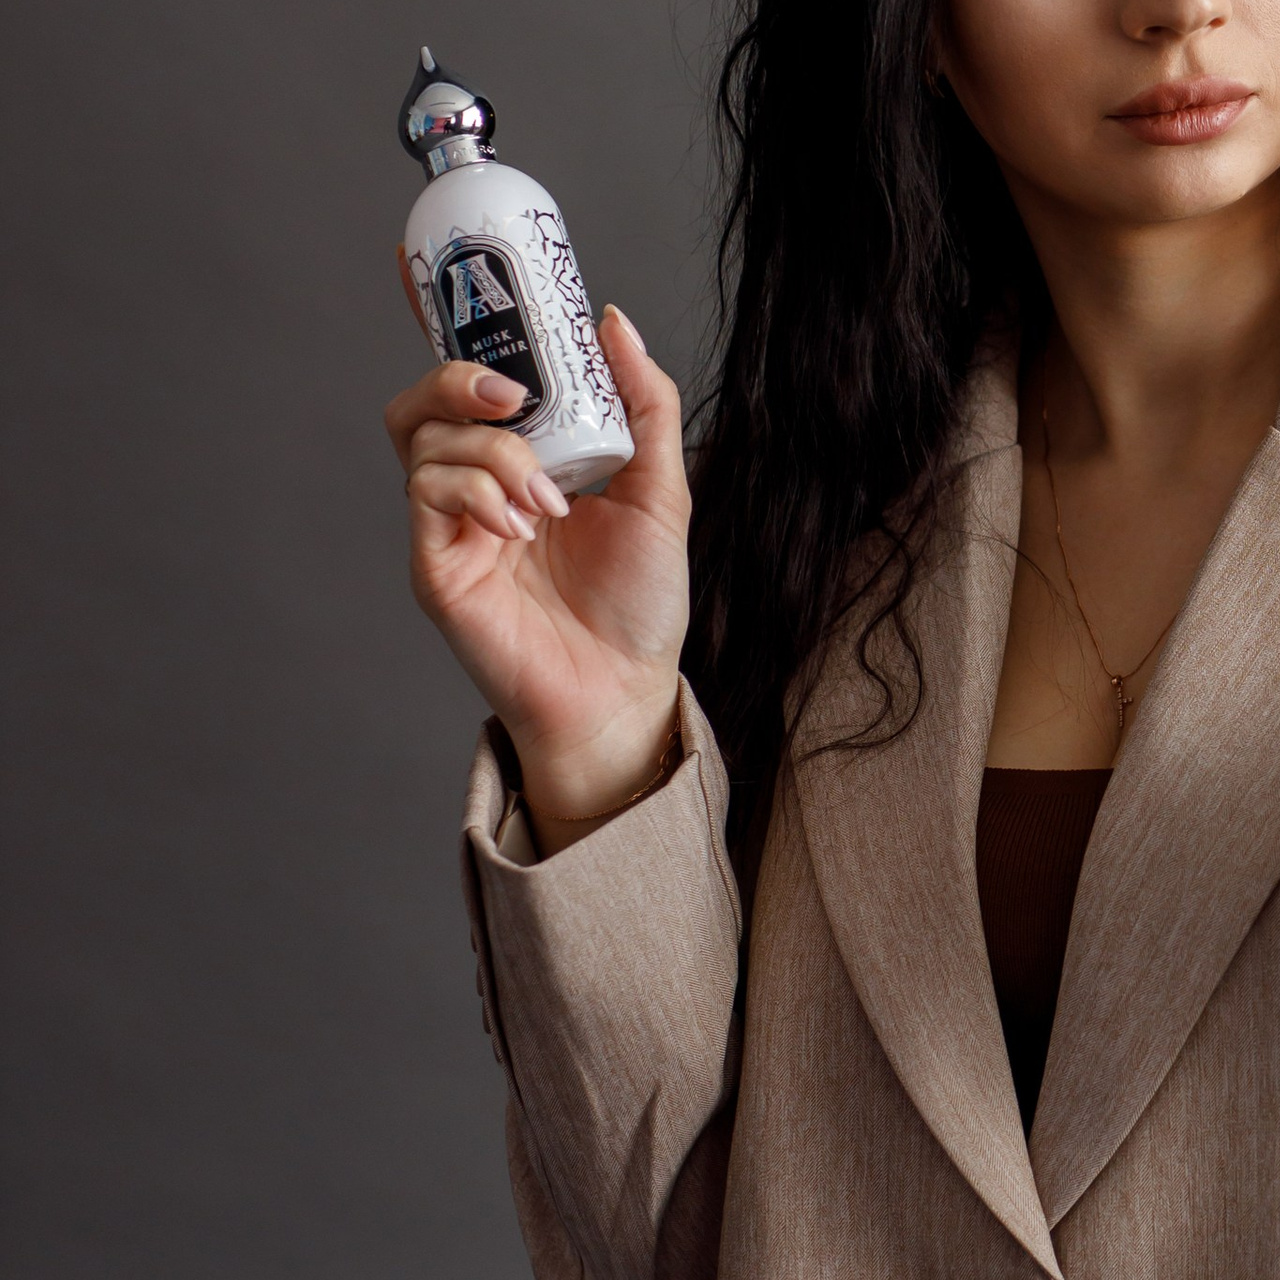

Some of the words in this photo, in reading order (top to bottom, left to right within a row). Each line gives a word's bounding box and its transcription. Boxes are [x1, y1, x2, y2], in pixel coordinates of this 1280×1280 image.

[448, 254, 516, 329] A
[468, 340, 528, 365] ASHMIR
[472, 329, 512, 353] MUSK
